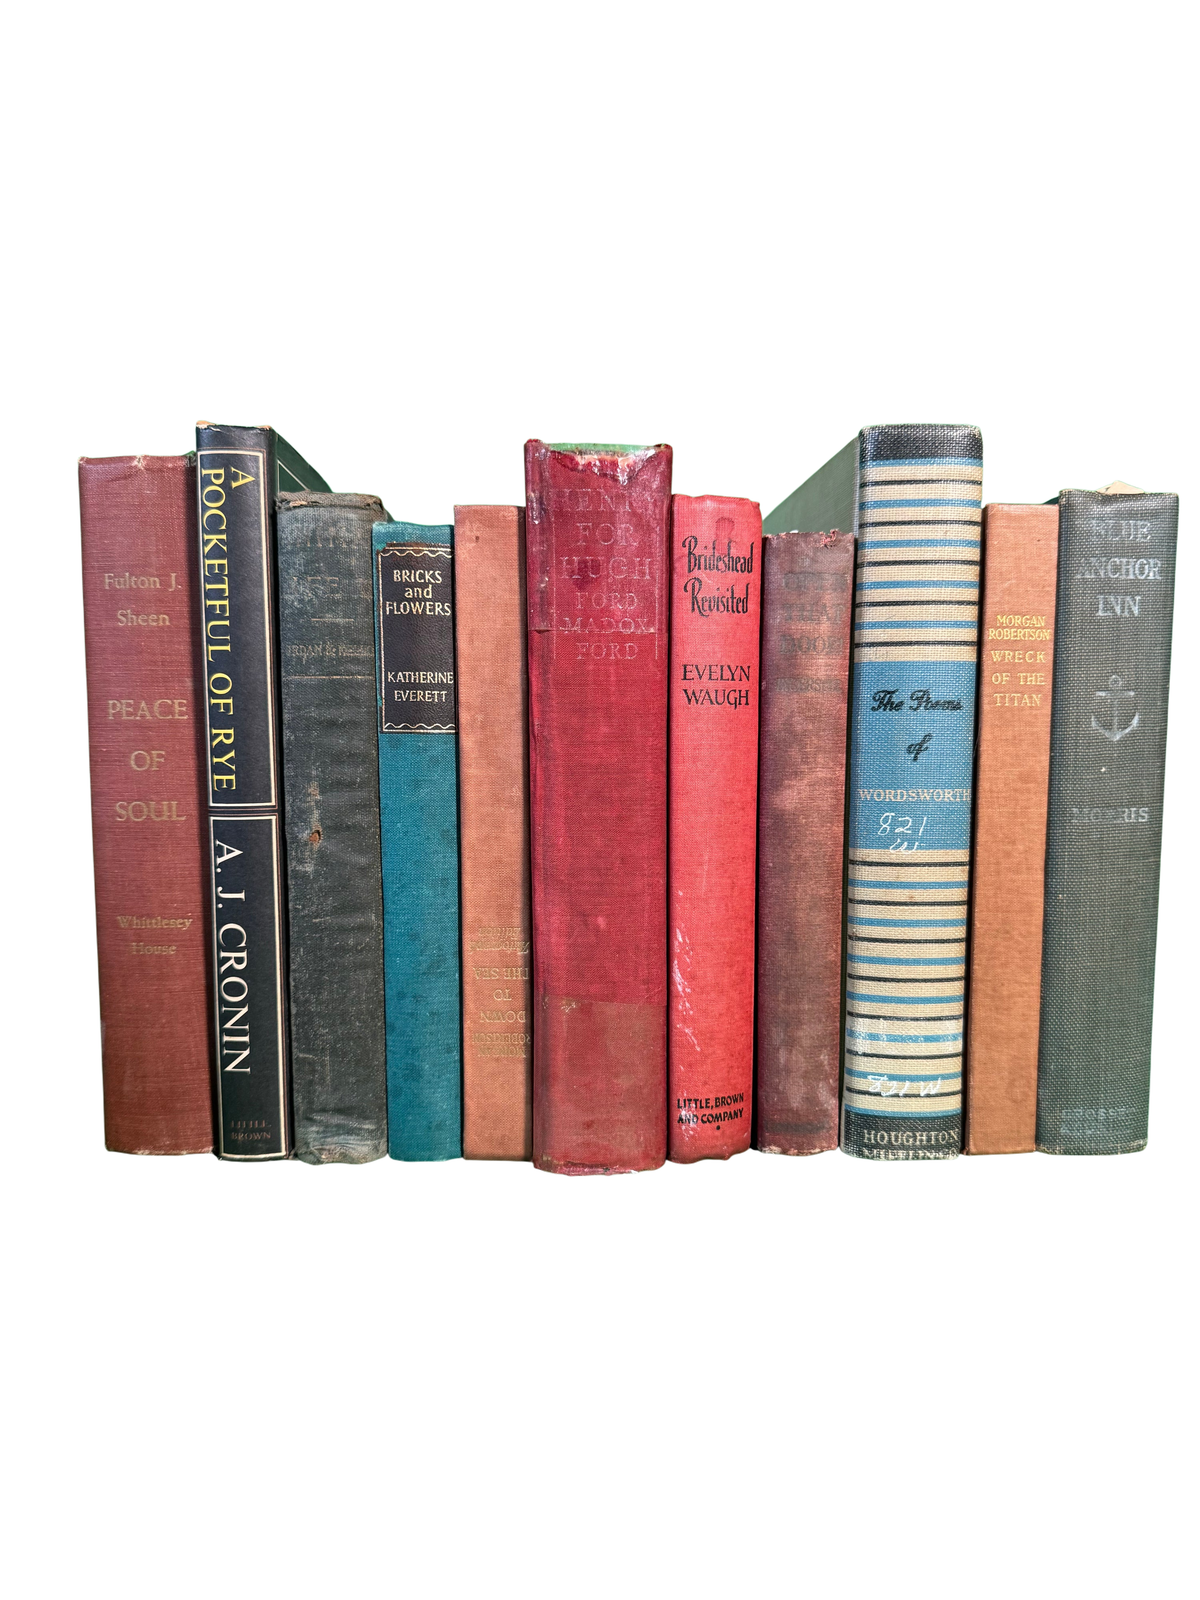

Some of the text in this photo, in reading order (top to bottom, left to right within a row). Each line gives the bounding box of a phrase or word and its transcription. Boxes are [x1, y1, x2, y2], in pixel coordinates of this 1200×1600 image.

[231, 467, 255, 489] A
[576, 522, 639, 546] FOR
[681, 535, 755, 574] Brideshead
[393, 569, 442, 584] BRICKS
[560, 556, 650, 580] HUGH
[1074, 557, 1162, 580] ANCHOR
[104, 572, 160, 590] Fulton
[404, 584, 433, 598] and
[683, 576, 749, 618] Revisited
[385, 601, 452, 616] FLOWERS
[576, 592, 637, 610] FORD
[1096, 595, 1142, 617] INN
[117, 609, 171, 627] Sheen
[560, 616, 649, 634] MADOX
[996, 614, 1046, 627] MORGAN
[201, 467, 237, 791] POCKETFUL OF RYE
[988, 628, 1051, 641] ROBERTSON
[576, 642, 638, 660] FORD
[990, 650, 1047, 663] WRECK
[387, 671, 454, 684] KATHERINE
[681, 663, 750, 682] EVELYN
[991, 672, 1046, 685] OF THE
[394, 690, 447, 703] EVERETT
[682, 689, 750, 710] WAUGH
[871, 688, 963, 713] The Poems
[993, 694, 1042, 707] TITAN
[108, 700, 188, 720] PEACE
[905, 732, 933, 762] of
[130, 750, 166, 770] OF
[857, 788, 972, 802] WORDSWORTH
[115, 801, 187, 821] SOUL
[878, 812, 927, 836] 821
[116, 915, 193, 931] Whittlesey
[131, 942, 177, 955] House
[215, 839, 251, 1075] A. J. CRONIN
[472, 967, 530, 980] THE SEA
[493, 989, 512, 1001] TO
[479, 1011, 527, 1023] DOWN
[867, 1075, 910, 1097] 821
[677, 1092, 744, 1110] LITTLE, BROWN
[677, 1108, 744, 1124] AND COMPANY
[231, 1131, 271, 1140] BROWN
[863, 1128, 959, 1145] HOUGHTON
